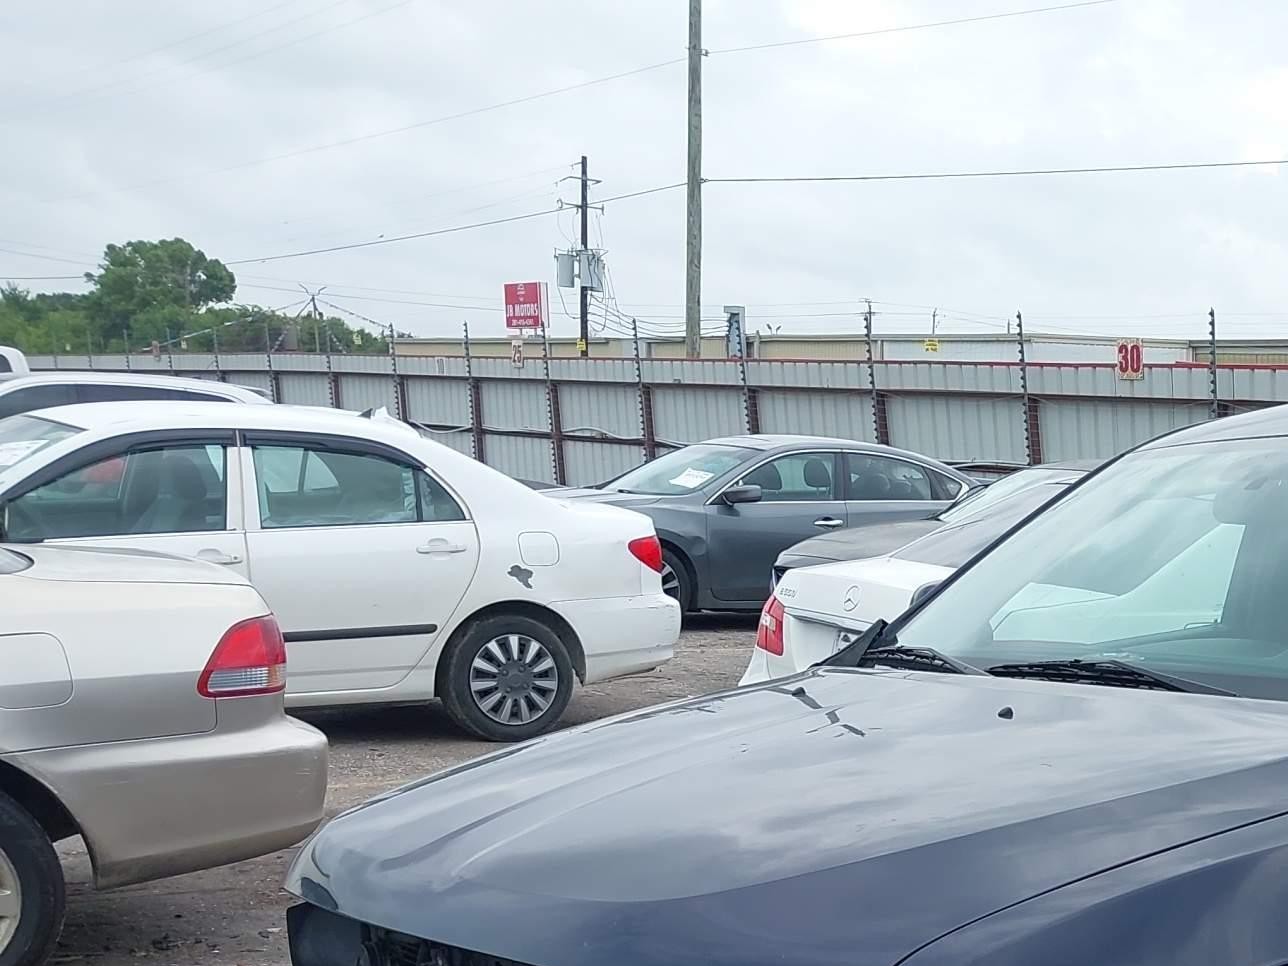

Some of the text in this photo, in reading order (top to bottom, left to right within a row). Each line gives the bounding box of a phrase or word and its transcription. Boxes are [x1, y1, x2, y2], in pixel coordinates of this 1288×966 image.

[514, 303, 538, 317] MOTORS
[512, 344, 522, 363] 25
[1118, 344, 1141, 373] 30
